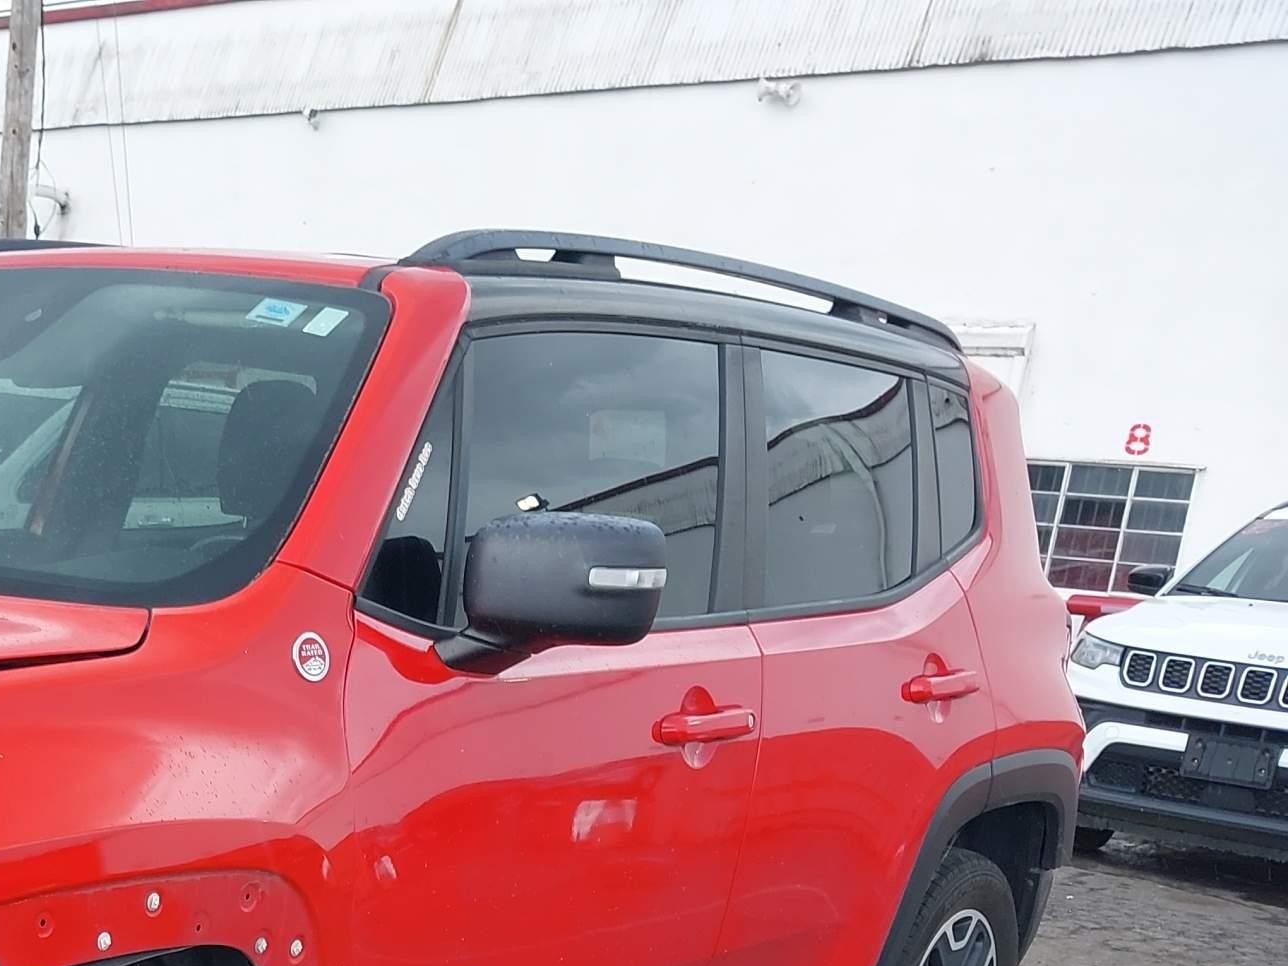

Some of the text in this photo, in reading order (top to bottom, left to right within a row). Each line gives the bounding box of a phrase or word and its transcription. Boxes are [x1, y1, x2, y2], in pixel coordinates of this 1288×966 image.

[1125, 424, 1151, 455] 8
[302, 643, 320, 651] TRAIL
[1247, 650, 1285, 665] Jeep
